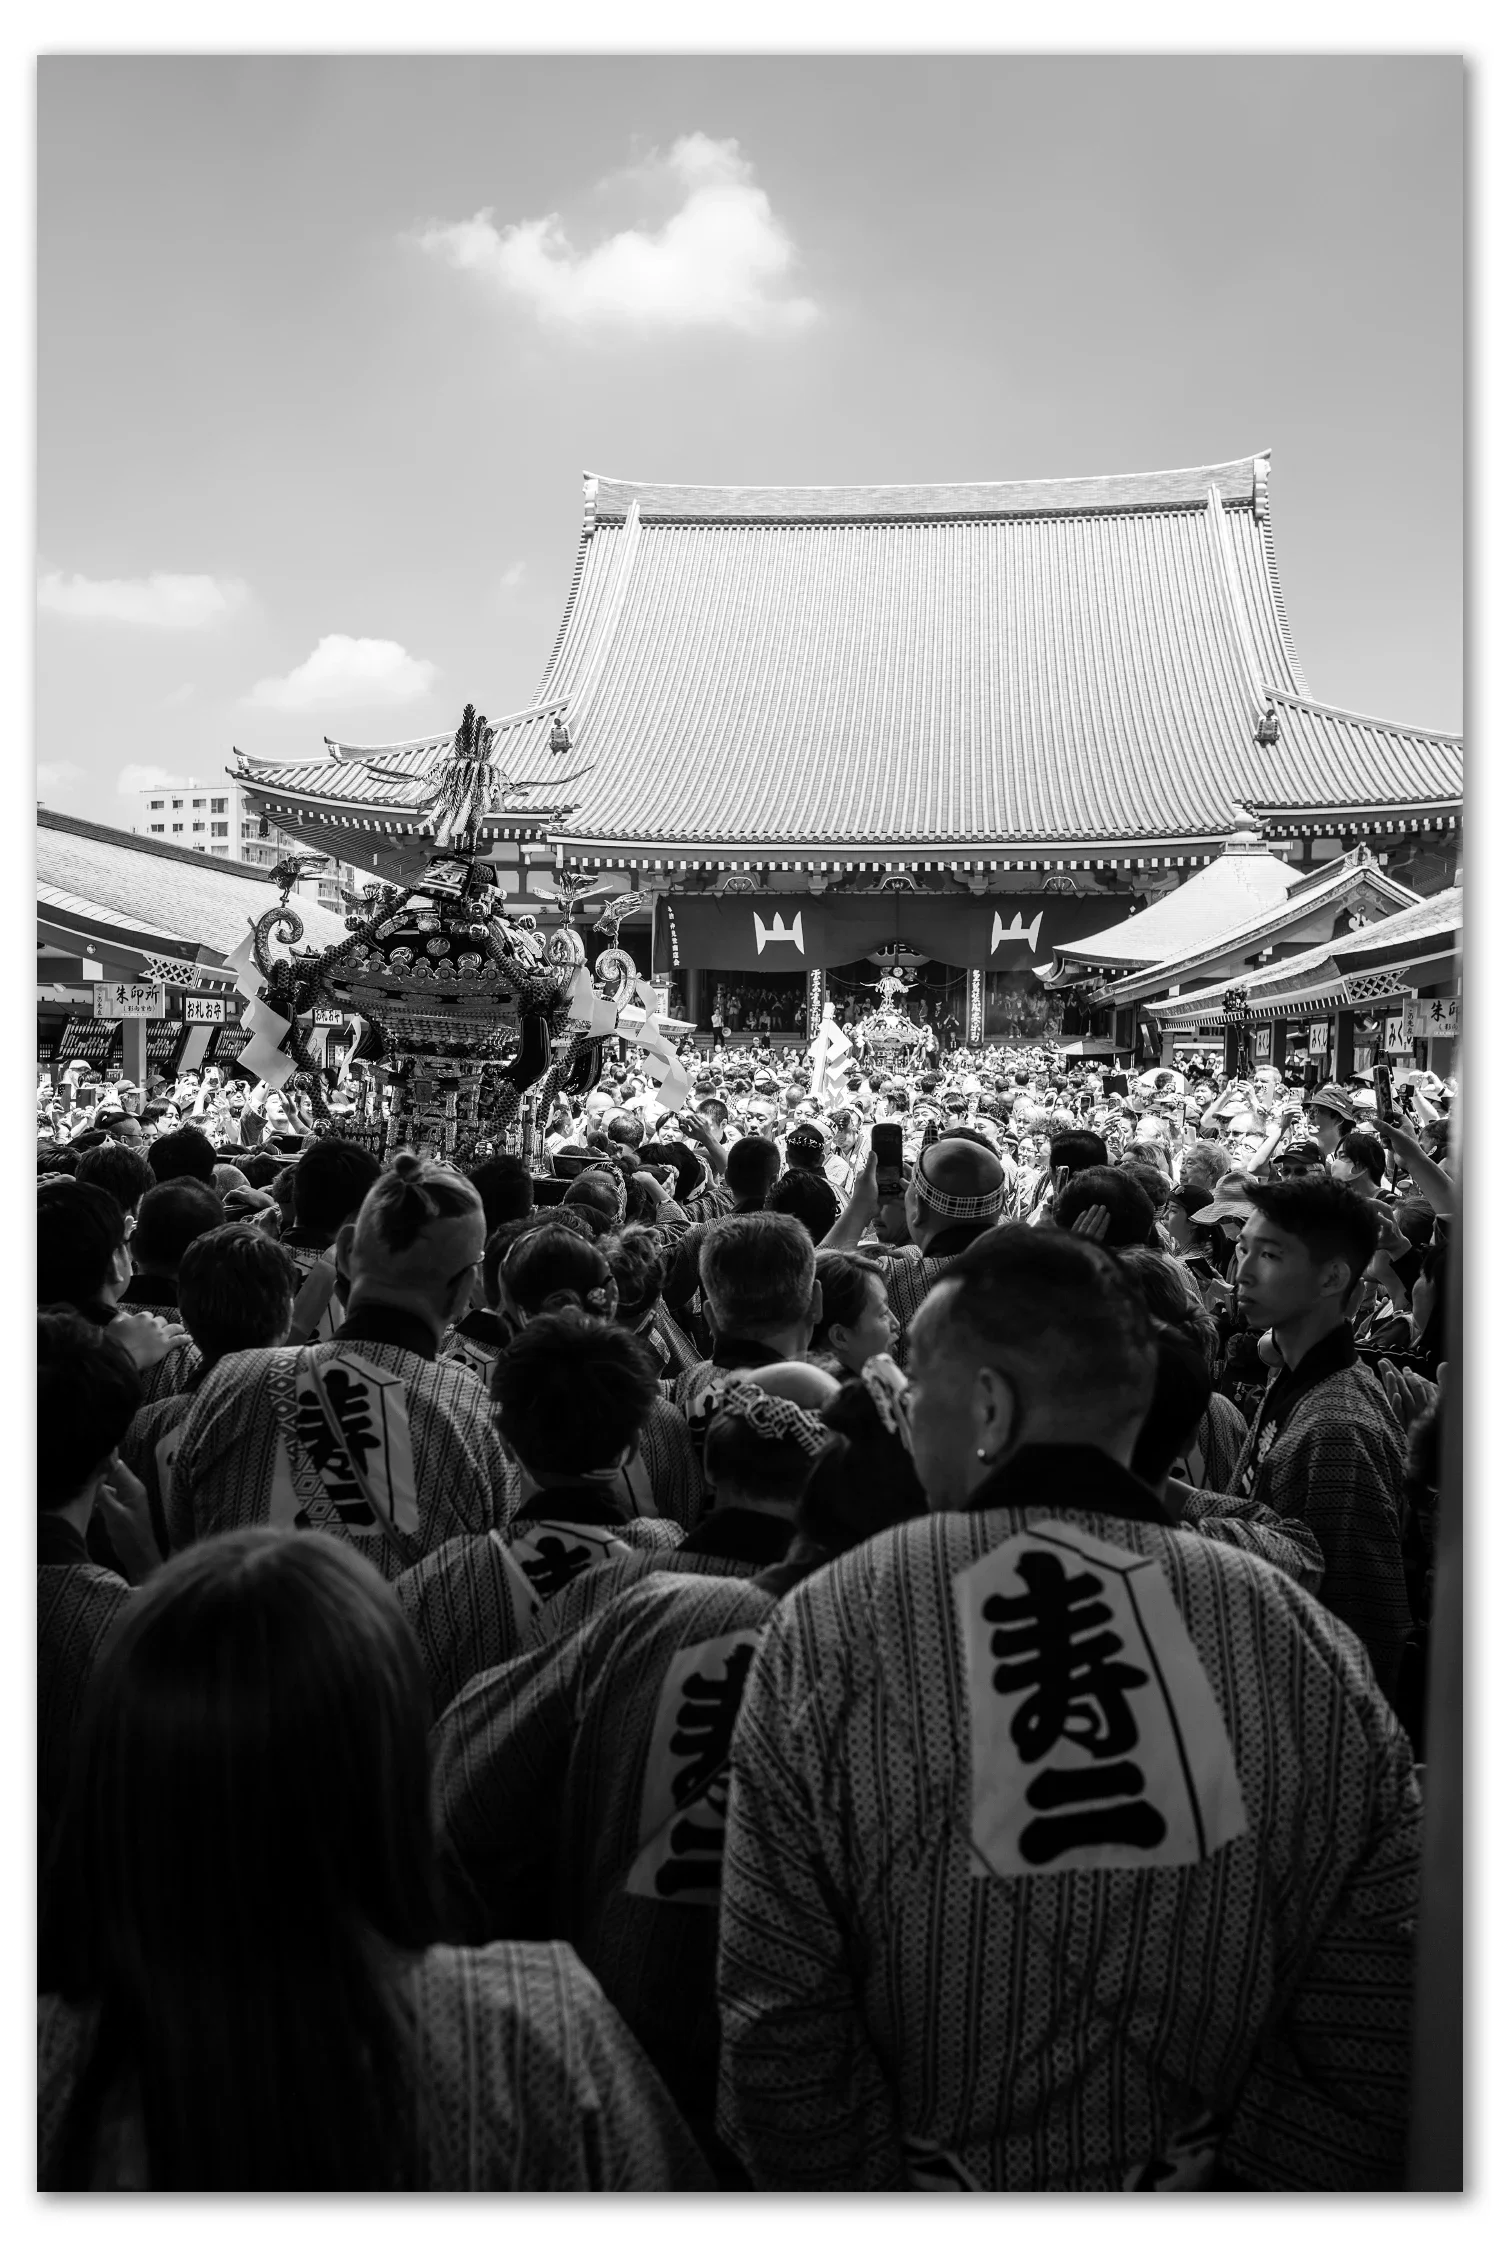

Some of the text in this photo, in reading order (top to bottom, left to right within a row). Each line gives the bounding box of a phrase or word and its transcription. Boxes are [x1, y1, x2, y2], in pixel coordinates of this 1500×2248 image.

[115, 984, 160, 1006] 朱印所
[187, 1001, 222, 1020] お札お守
[983, 1550, 1166, 1865] 寿二
